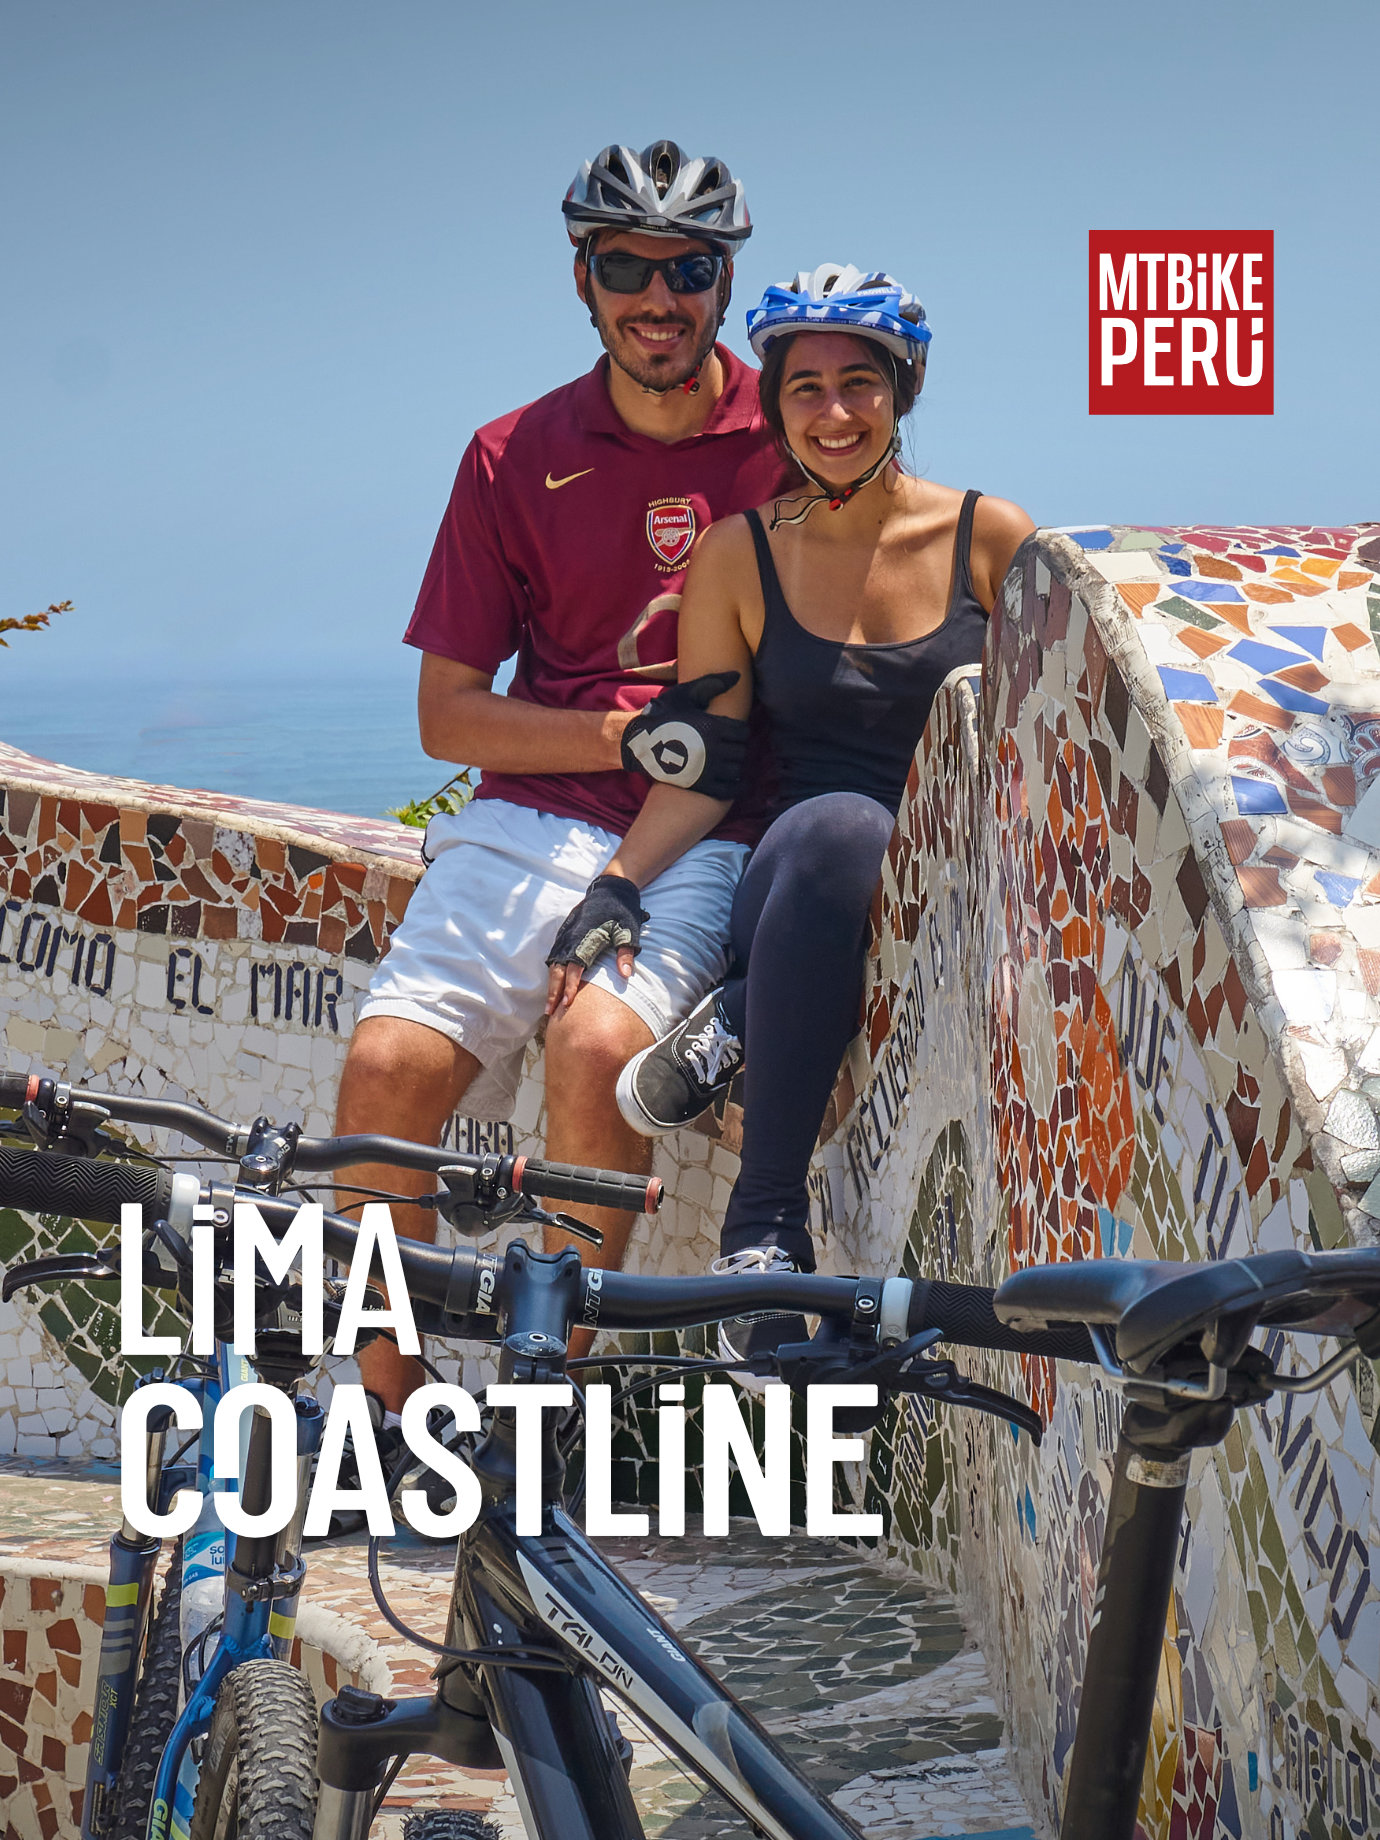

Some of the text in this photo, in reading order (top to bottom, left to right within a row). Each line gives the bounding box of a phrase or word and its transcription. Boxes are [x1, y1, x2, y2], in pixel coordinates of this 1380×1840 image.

[648, 497, 691, 508] HIGHBURY
[653, 514, 688, 525] Arsenal
[251, 961, 343, 1035] MAR
[1260, 1331, 1371, 1641] LVIDO
[544, 1591, 634, 1690] TALON
[646, 1627, 687, 1663] GIANT
[108, 1687, 119, 1709] XCT
